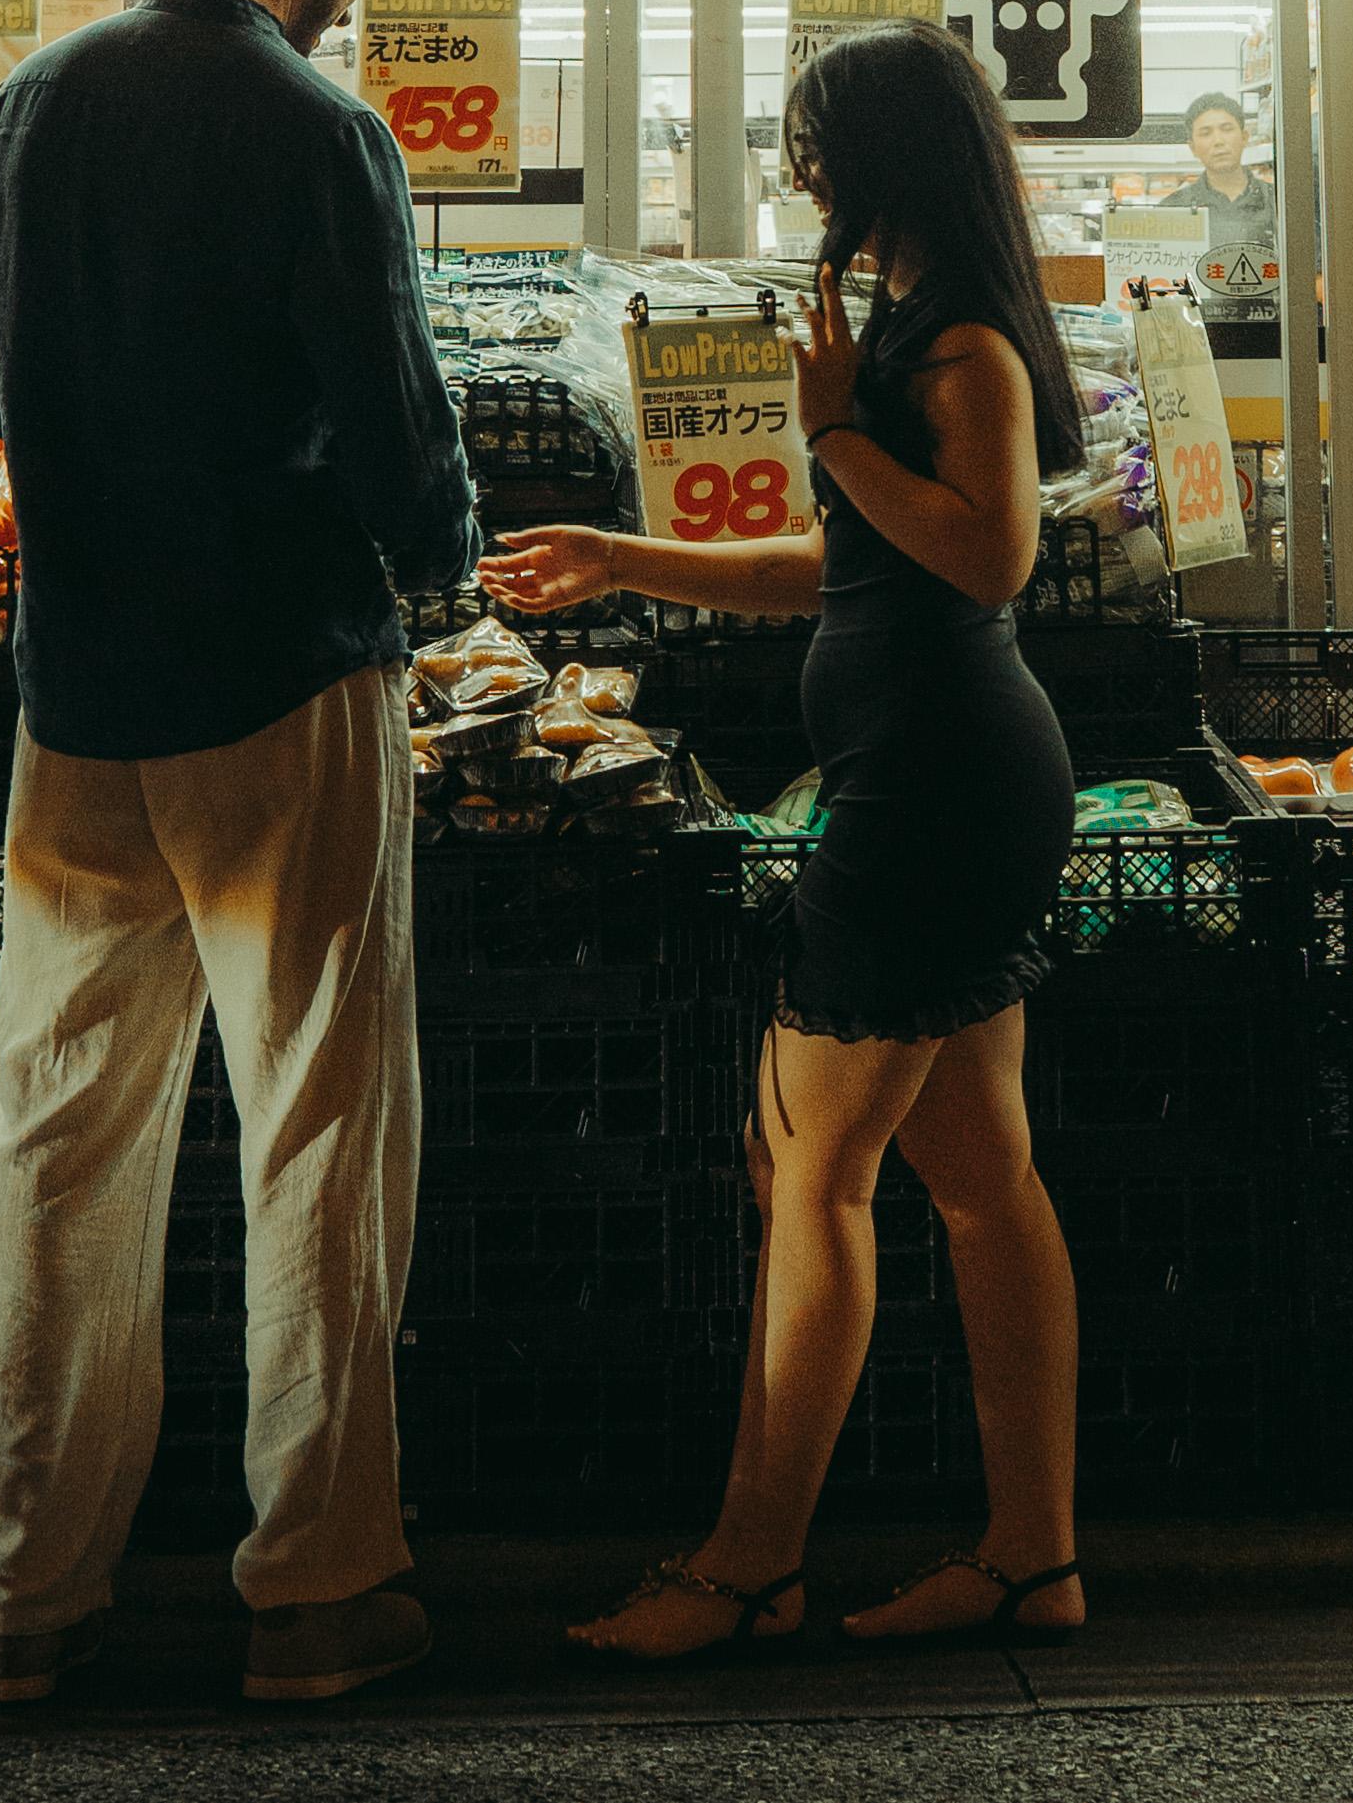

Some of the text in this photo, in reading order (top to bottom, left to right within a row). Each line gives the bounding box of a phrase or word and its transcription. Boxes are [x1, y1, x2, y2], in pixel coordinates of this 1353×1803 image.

[366, 22, 448, 33] 産地は商品に記載
[366, 34, 479, 63] えだまめ
[386, 84, 500, 153] 158
[470, 250, 550, 271] あきたの枝豆
[640, 330, 788, 380] LowPrice!
[641, 387, 728, 406] 産地は商品に記載
[642, 401, 788, 441] 国産オクラ
[670, 458, 805, 543] 98 円
[1173, 441, 1225, 525] 298
